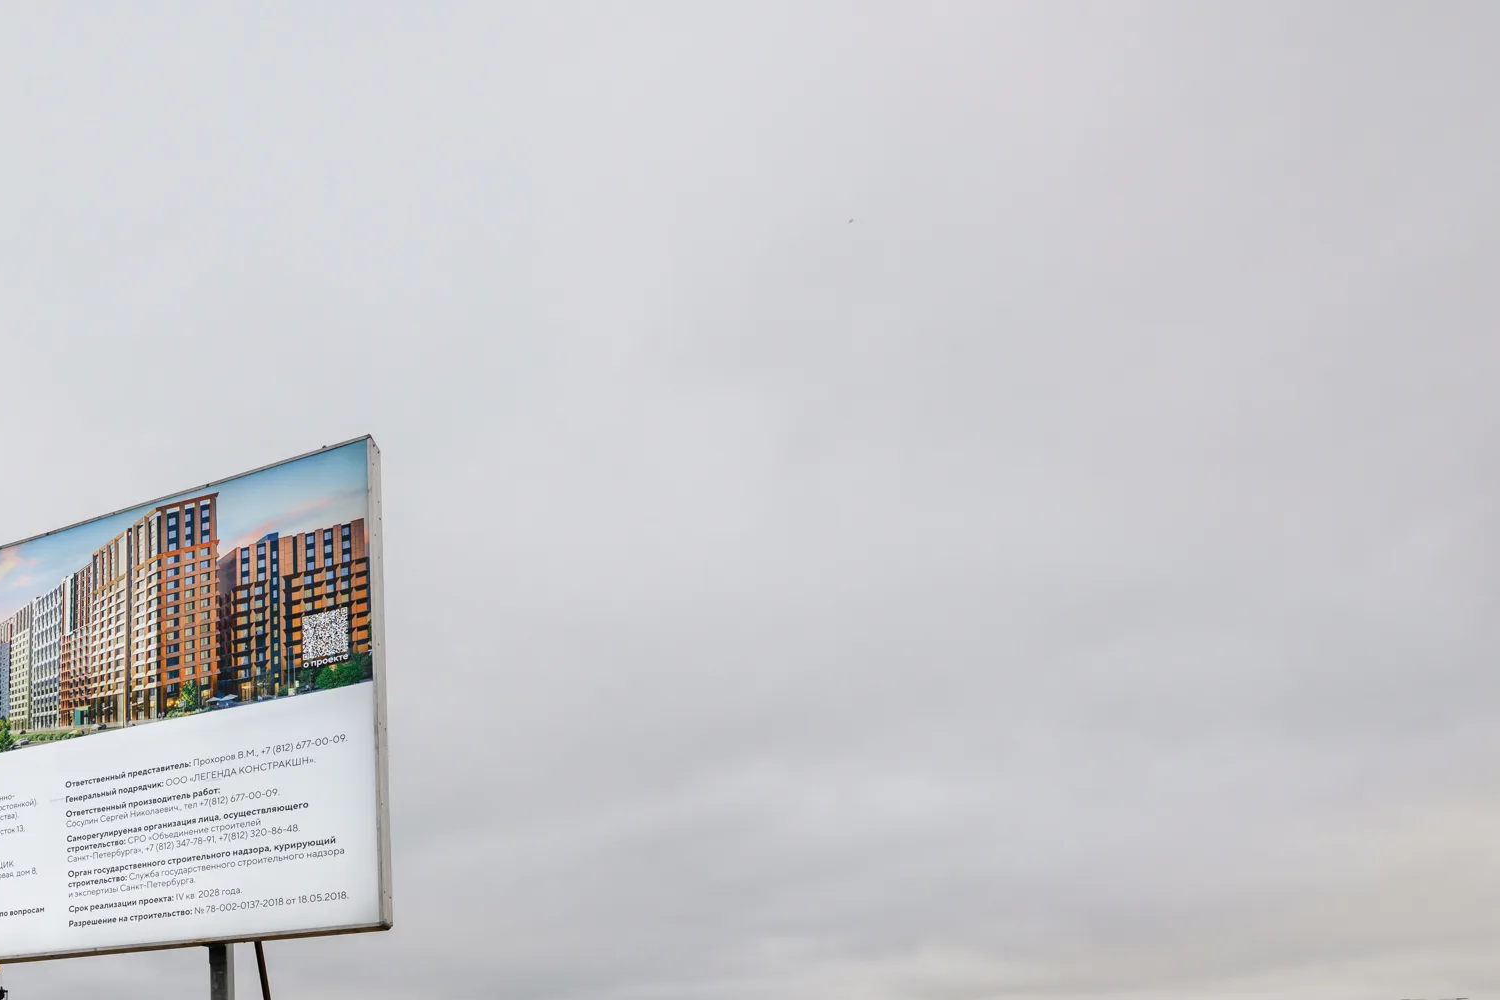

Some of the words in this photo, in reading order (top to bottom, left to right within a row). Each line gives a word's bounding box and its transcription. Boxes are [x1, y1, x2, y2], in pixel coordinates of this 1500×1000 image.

[310, 652, 349, 668] проекте
[64, 770, 126, 788] Ответственный
[127, 760, 191, 779] представитель:
[192, 752, 235, 768] Прохоров
[237, 748, 258, 760] В.М.,
[260, 745, 270, 755] +7
[272, 742, 293, 755] (812)
[295, 732, 347, 750] 677-00-09.
[65, 787, 116, 804] Генеральный
[118, 781, 164, 795] подрядчик:
[165, 774, 187, 787] ООО
[189, 766, 237, 783] «ЛЕГЕНДА
[238, 754, 315, 775] КОНСТРАКШН».
[65, 800, 126, 818] Ответственный
[127, 792, 191, 809] производитель
[192, 786, 220, 799] работ:
[65, 816, 98, 829] Сосулин
[99, 810, 128, 824] Сергей
[183, 801, 197, 810] тел
[199, 794, 228, 808] +7(812)
[229, 787, 280, 803] 677-00-09.
[16, 823, 25, 833] 13,
[66, 824, 142, 843] Саморегулируемая
[143, 817, 196, 833] организация
[197, 814, 221, 824] лица,
[222, 801, 309, 821] осуществляющего
[66, 838, 126, 854] строительство:
[127, 833, 146, 844] СРО
[147, 825, 209, 841] «Объединение
[210, 817, 261, 833] строителей
[66, 845, 143, 864] Санкт-Петербурга»,
[145, 842, 154, 852] +7
[155, 840, 174, 852] (812)
[175, 834, 216, 848] 347-78-91,
[218, 829, 248, 843] +7(812)
[249, 822, 300, 838] 320-86-48.
[67, 868, 92, 879] Орган
[93, 859, 166, 875] государственного
[167, 850, 231, 866] строительного
[232, 845, 271, 857] надзора,
[273, 835, 336, 853] курирующий
[15, 869, 30, 877] дом
[67, 874, 127, 889] строительство:
[128, 868, 159, 882] Служба
[160, 859, 236, 878] государственного
[237, 850, 304, 868] строительного
[306, 847, 344, 859] надзора
[74, 886, 118, 898] экспертизы
[119, 876, 195, 893] Санкт-Петербурга.
[9, 906, 44, 916] вопросам
[68, 903, 88, 914] Срок
[89, 899, 136, 912] реализации
[138, 895, 174, 907] проекта:
[175, 892, 184, 901] IV
[198, 887, 220, 898] 2028
[221, 887, 242, 896] года.
[68, 915, 117, 929] Разрешение
[129, 908, 192, 922] строительство:
[205, 896, 284, 913] 78-002-0137-2018
[285, 897, 296, 905] от
[297, 890, 348, 904] 18.05.2018.
